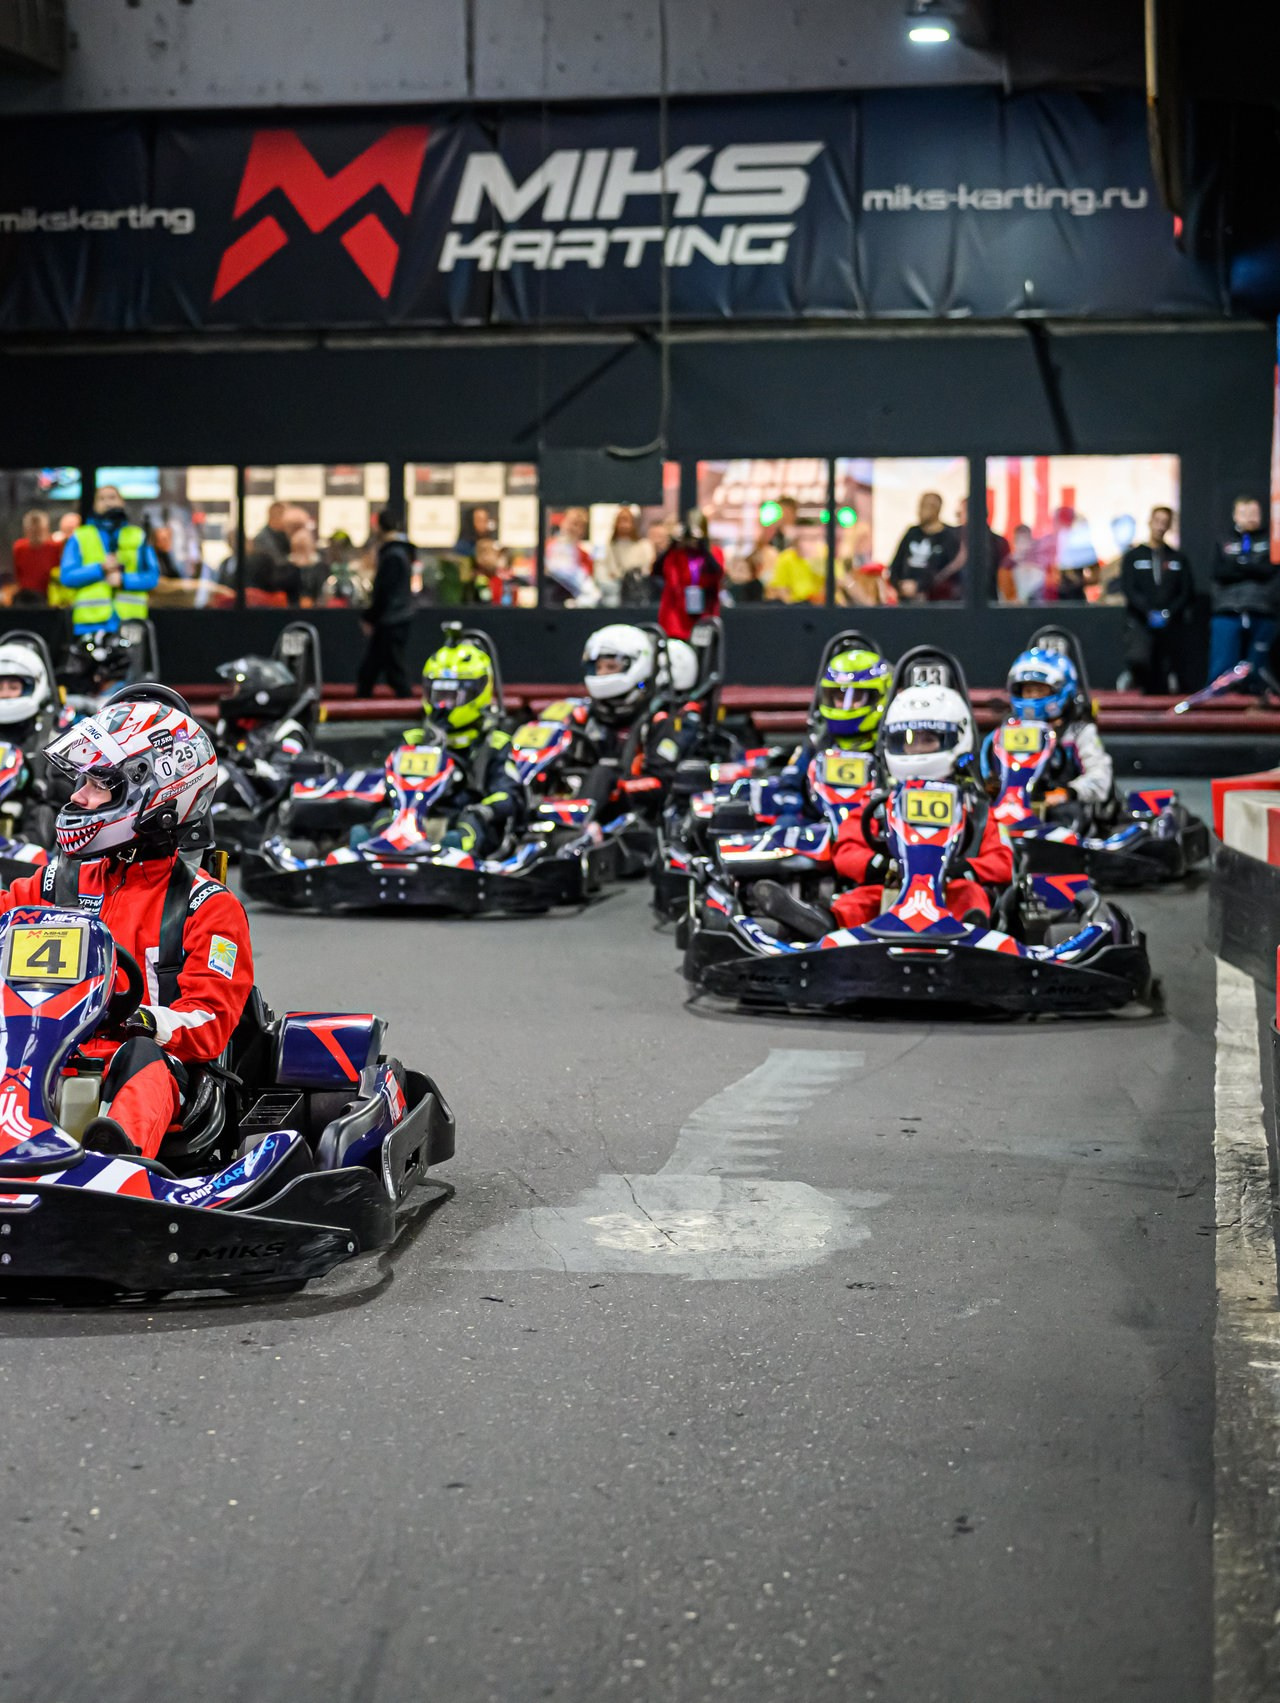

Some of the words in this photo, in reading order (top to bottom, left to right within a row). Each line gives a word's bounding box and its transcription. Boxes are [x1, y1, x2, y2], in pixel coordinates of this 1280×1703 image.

[450, 141, 825, 224] MIKS
[862, 184, 1149, 216] miks-karting.ru
[436, 222, 797, 273] KARTING
[1014, 733, 1029, 746] 9
[175, 745, 194, 764] 25
[161, 761, 172, 777] 0
[407, 758, 432, 775] 11
[837, 764, 856, 783] 6
[911, 799, 949, 820] 10
[189, 884, 224, 910] sparco
[26, 939, 67, 974] 4
[194, 1242, 287, 1260] MIKS
